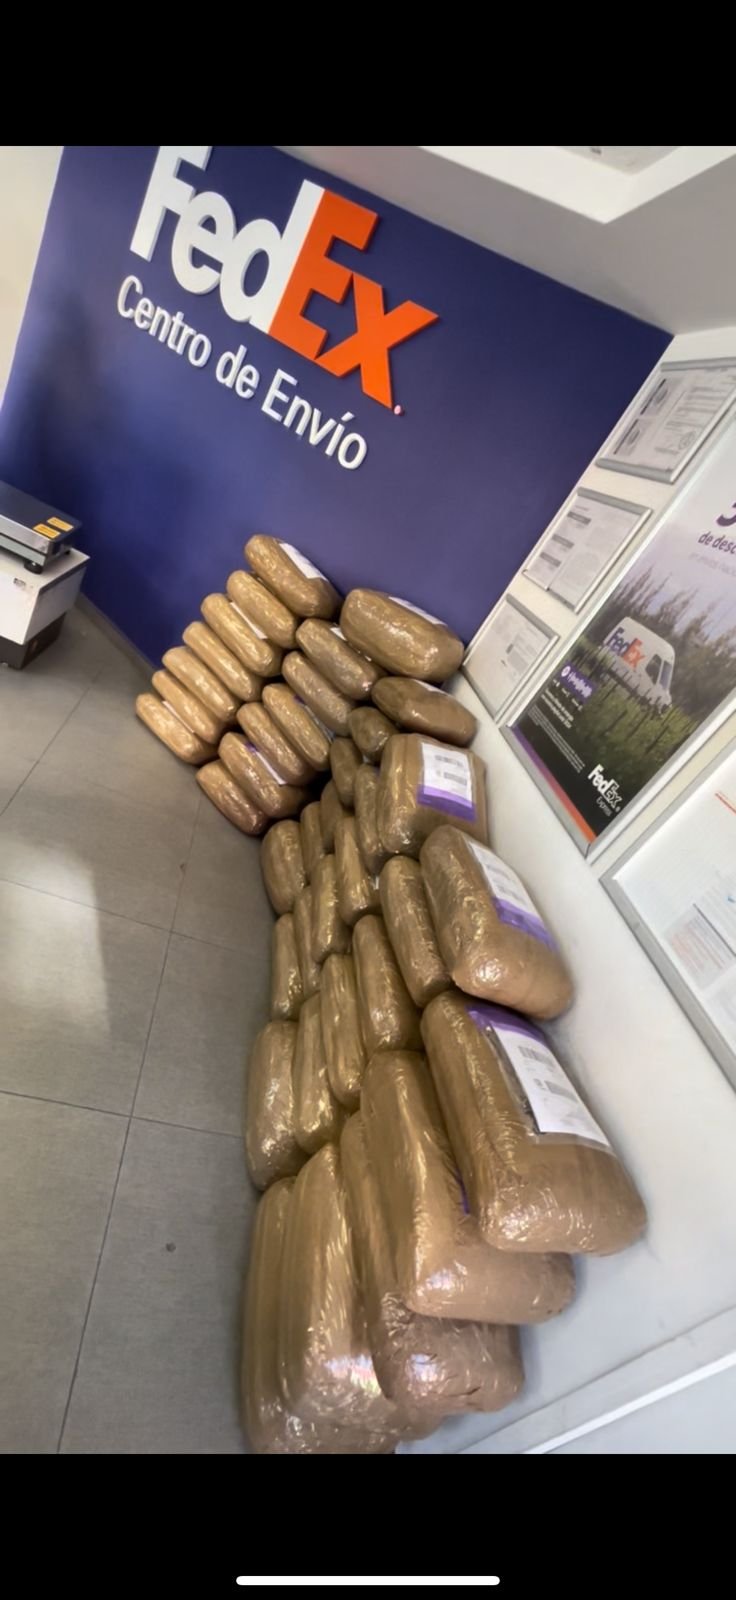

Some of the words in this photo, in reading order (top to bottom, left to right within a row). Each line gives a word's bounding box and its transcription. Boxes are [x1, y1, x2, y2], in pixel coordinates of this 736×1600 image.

[129, 146, 439, 409] FedEx
[117, 275, 213, 368] Centro
[215, 345, 260, 399] de
[261, 368, 367, 471] Envío
[698, 531, 714, 546] de
[606, 627, 646, 671] FedEx
[588, 764, 622, 808] FedEx
